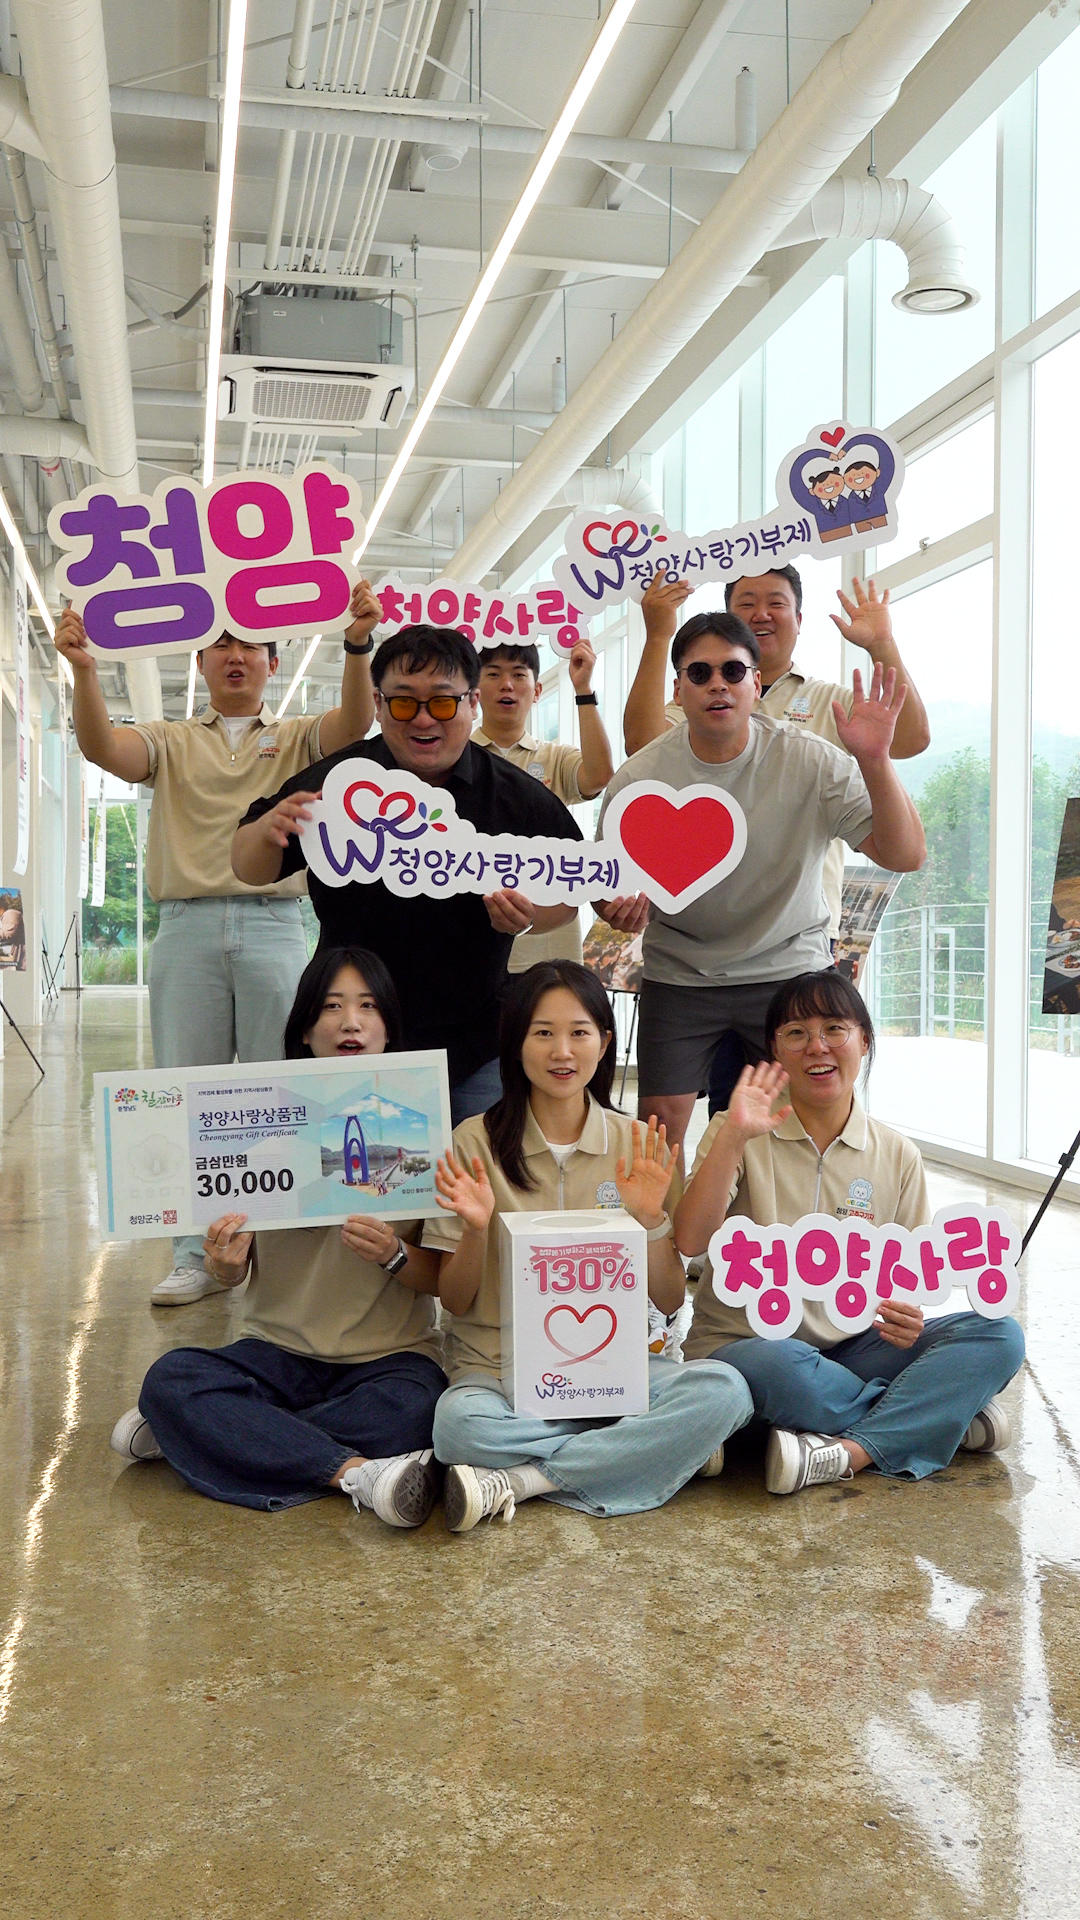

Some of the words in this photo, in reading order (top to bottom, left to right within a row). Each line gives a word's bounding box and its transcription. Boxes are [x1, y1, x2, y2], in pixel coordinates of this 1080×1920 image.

[60, 472, 355, 649] 청양
[629, 518, 812, 590] 청양사랑기부제
[389, 848, 620, 891] 청양사랑기부제
[199, 1105, 307, 1128] 청양사랑상품권
[199, 1133, 244, 1141] Cheongyang
[246, 1131, 260, 1139] Gift
[261, 1129, 299, 1138] Certificate
[196, 1154, 249, 1170] 금삼만원
[197, 1168, 294, 1198] 30,000
[130, 1214, 161, 1225] 청양군수
[532, 1257, 636, 1293] 130%
[722, 1216, 1010, 1325] 청양사랑
[557, 1386, 625, 1400] 청양사랑기부제
